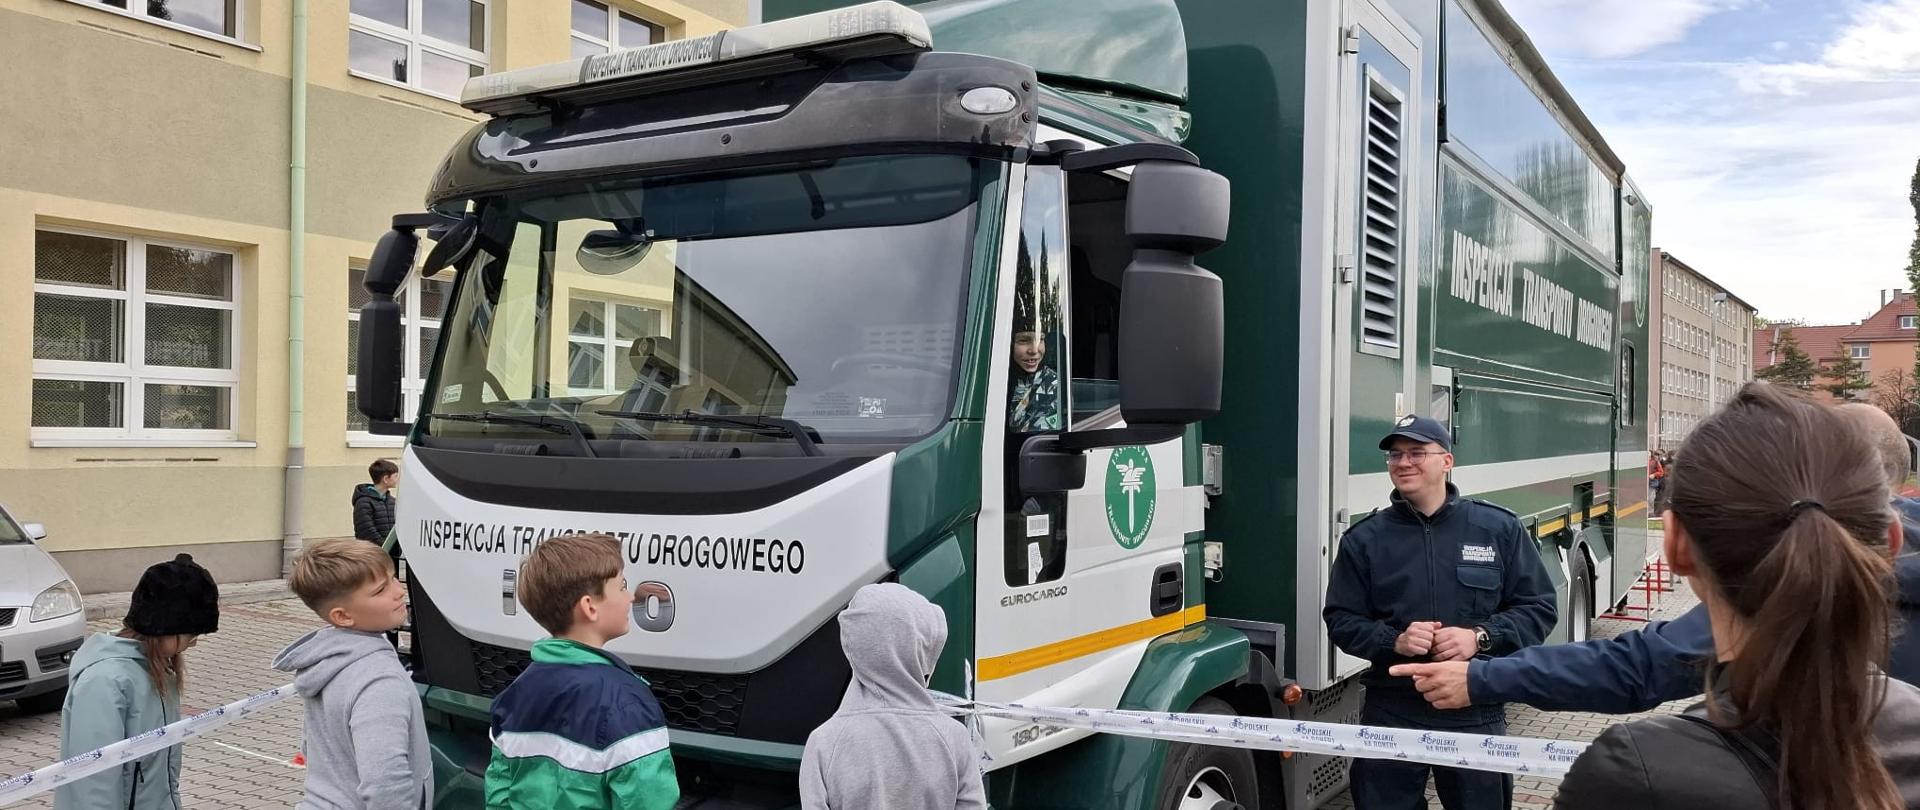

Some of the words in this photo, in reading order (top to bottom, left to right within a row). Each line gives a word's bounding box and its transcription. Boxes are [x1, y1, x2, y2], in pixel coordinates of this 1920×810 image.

[586, 54, 623, 79] INSPEKCJA
[623, 43, 668, 73] TRANSPORTU
[668, 35, 715, 64] DROGOWEGO
[1450, 229, 1514, 318] INSPEKCJA
[1522, 267, 1574, 339] TRANSPORTU
[419, 519, 506, 554] INSPEKCJA
[513, 526, 643, 564] TRATU
[648, 534, 805, 575] DROGOWEGO
[1000, 585, 1068, 608] EUROCARGO
